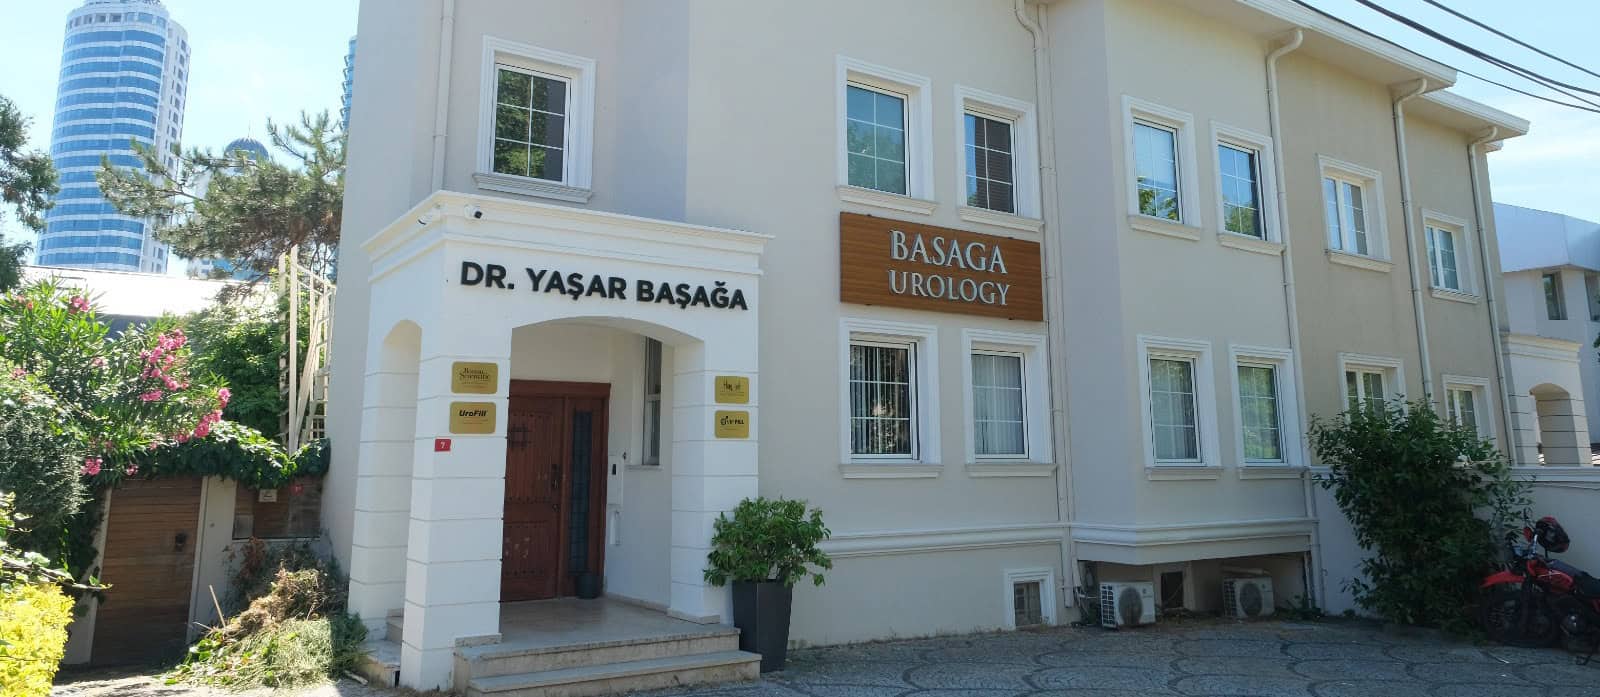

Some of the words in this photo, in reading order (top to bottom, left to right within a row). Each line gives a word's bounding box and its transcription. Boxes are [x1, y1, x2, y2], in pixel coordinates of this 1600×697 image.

[889, 229, 1009, 274] BASAGA
[460, 261, 515, 290] DR.
[526, 267, 627, 301] YAŞAR
[636, 279, 748, 310] BAŞAĞA
[888, 269, 1011, 306] UROLOGY
[459, 409, 487, 417] UroFill
